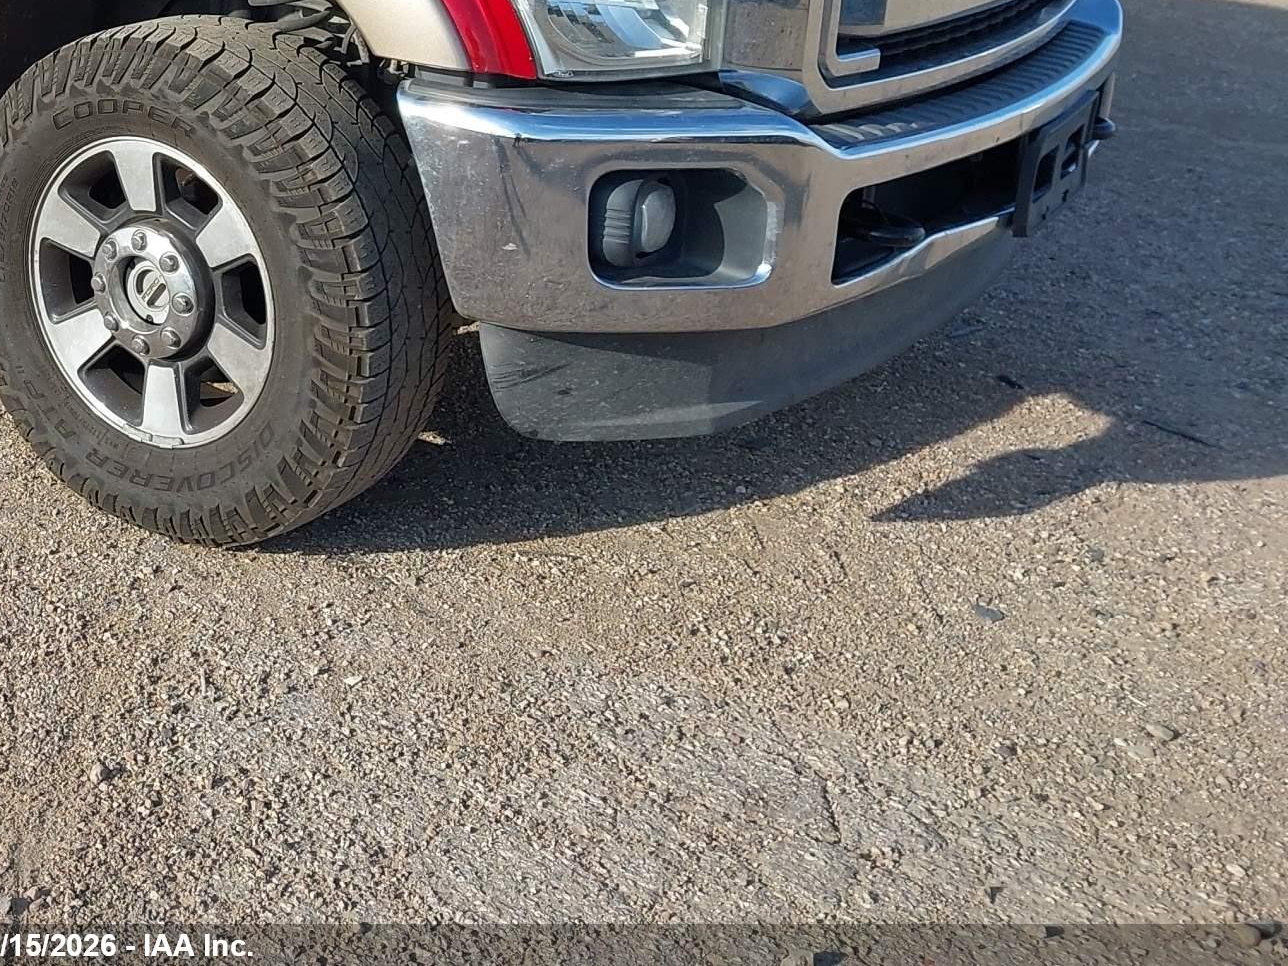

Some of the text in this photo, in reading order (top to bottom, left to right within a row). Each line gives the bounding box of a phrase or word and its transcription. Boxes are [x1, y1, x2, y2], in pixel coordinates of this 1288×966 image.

[52, 98, 195, 138] COOPER
[142, 277, 160, 302] FORD
[85, 420, 276, 492] DISCOVERER
